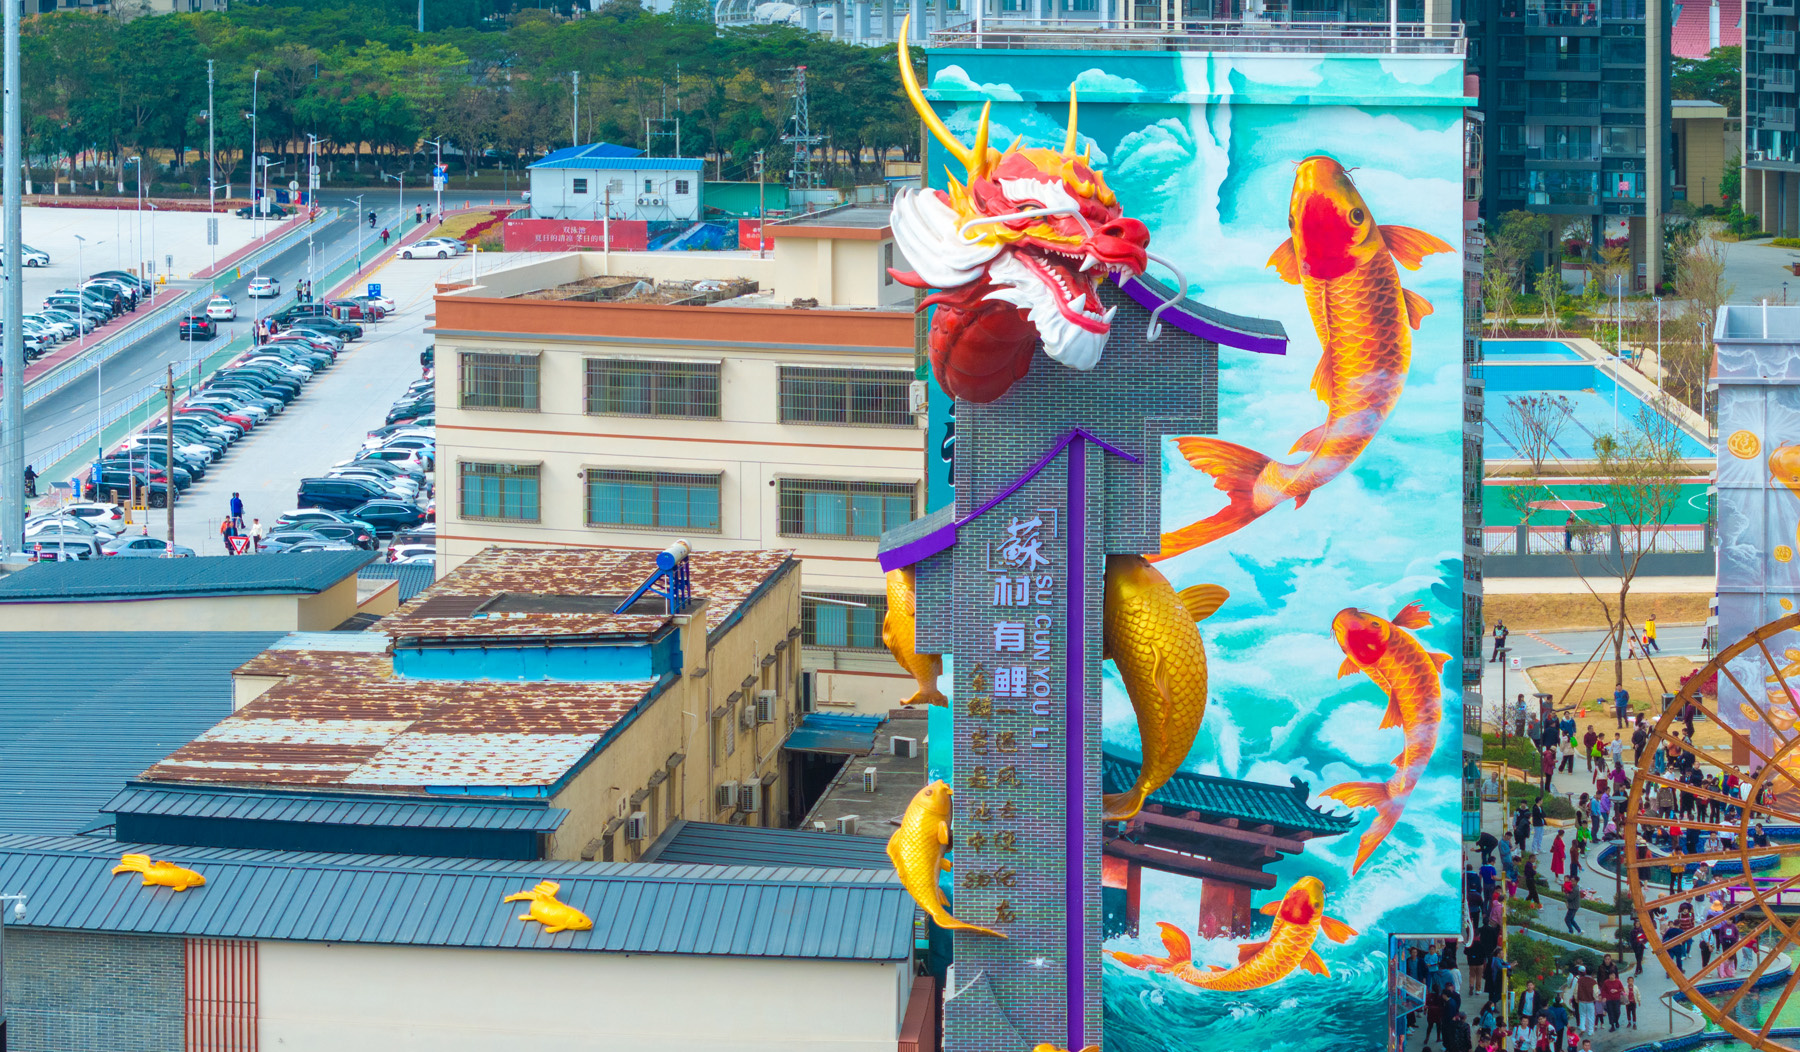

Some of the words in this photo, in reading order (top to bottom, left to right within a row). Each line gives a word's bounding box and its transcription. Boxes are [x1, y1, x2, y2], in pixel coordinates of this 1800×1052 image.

[1034, 575, 1052, 606] SU
[1033, 614, 1052, 661] CUN
[1031, 667, 1051, 716] YOU
[1031, 726, 1049, 749] LI
